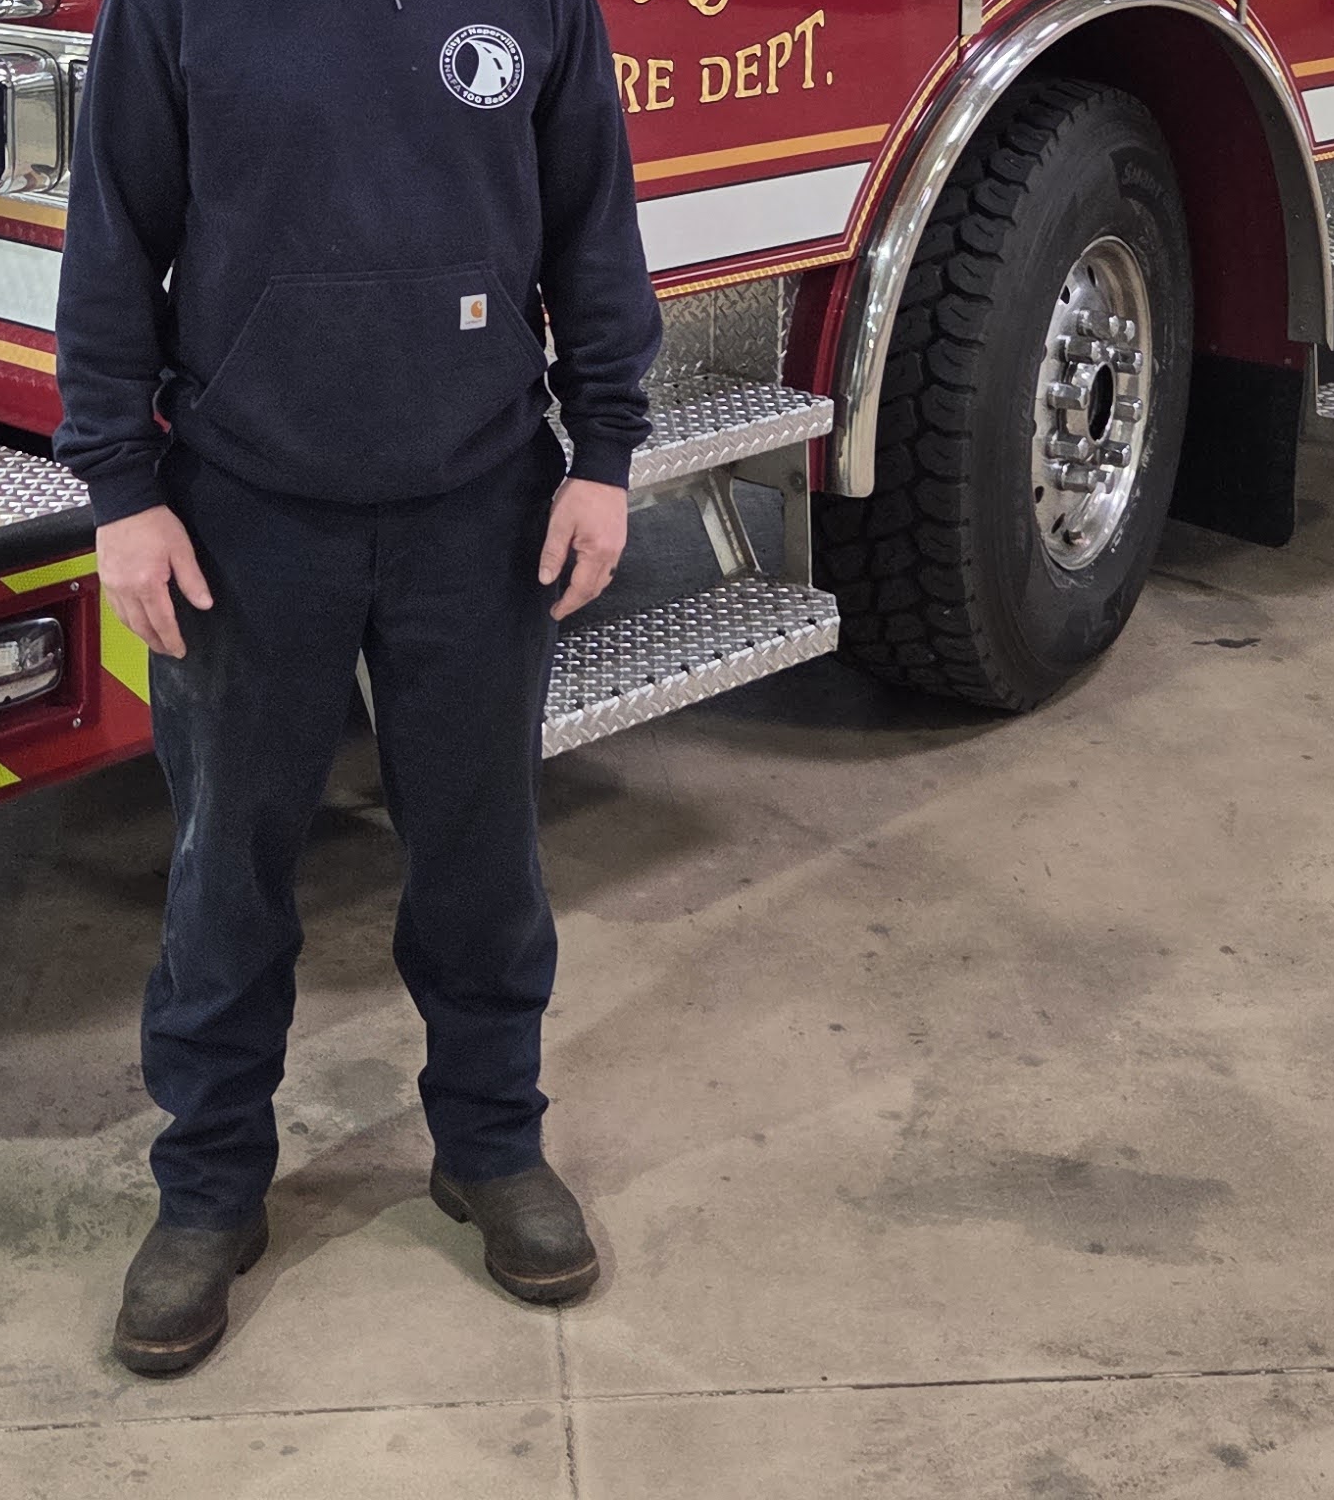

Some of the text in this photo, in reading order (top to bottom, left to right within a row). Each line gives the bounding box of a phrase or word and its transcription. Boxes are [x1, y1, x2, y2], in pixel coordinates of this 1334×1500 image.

[445, 36, 461, 57] City
[467, 27, 517, 54] Naperville
[612, 9, 835, 115] RE DEPT.
[444, 64, 461, 92] NAFA
[462, 90, 482, 104] 100
[484, 92, 508, 105] Best
